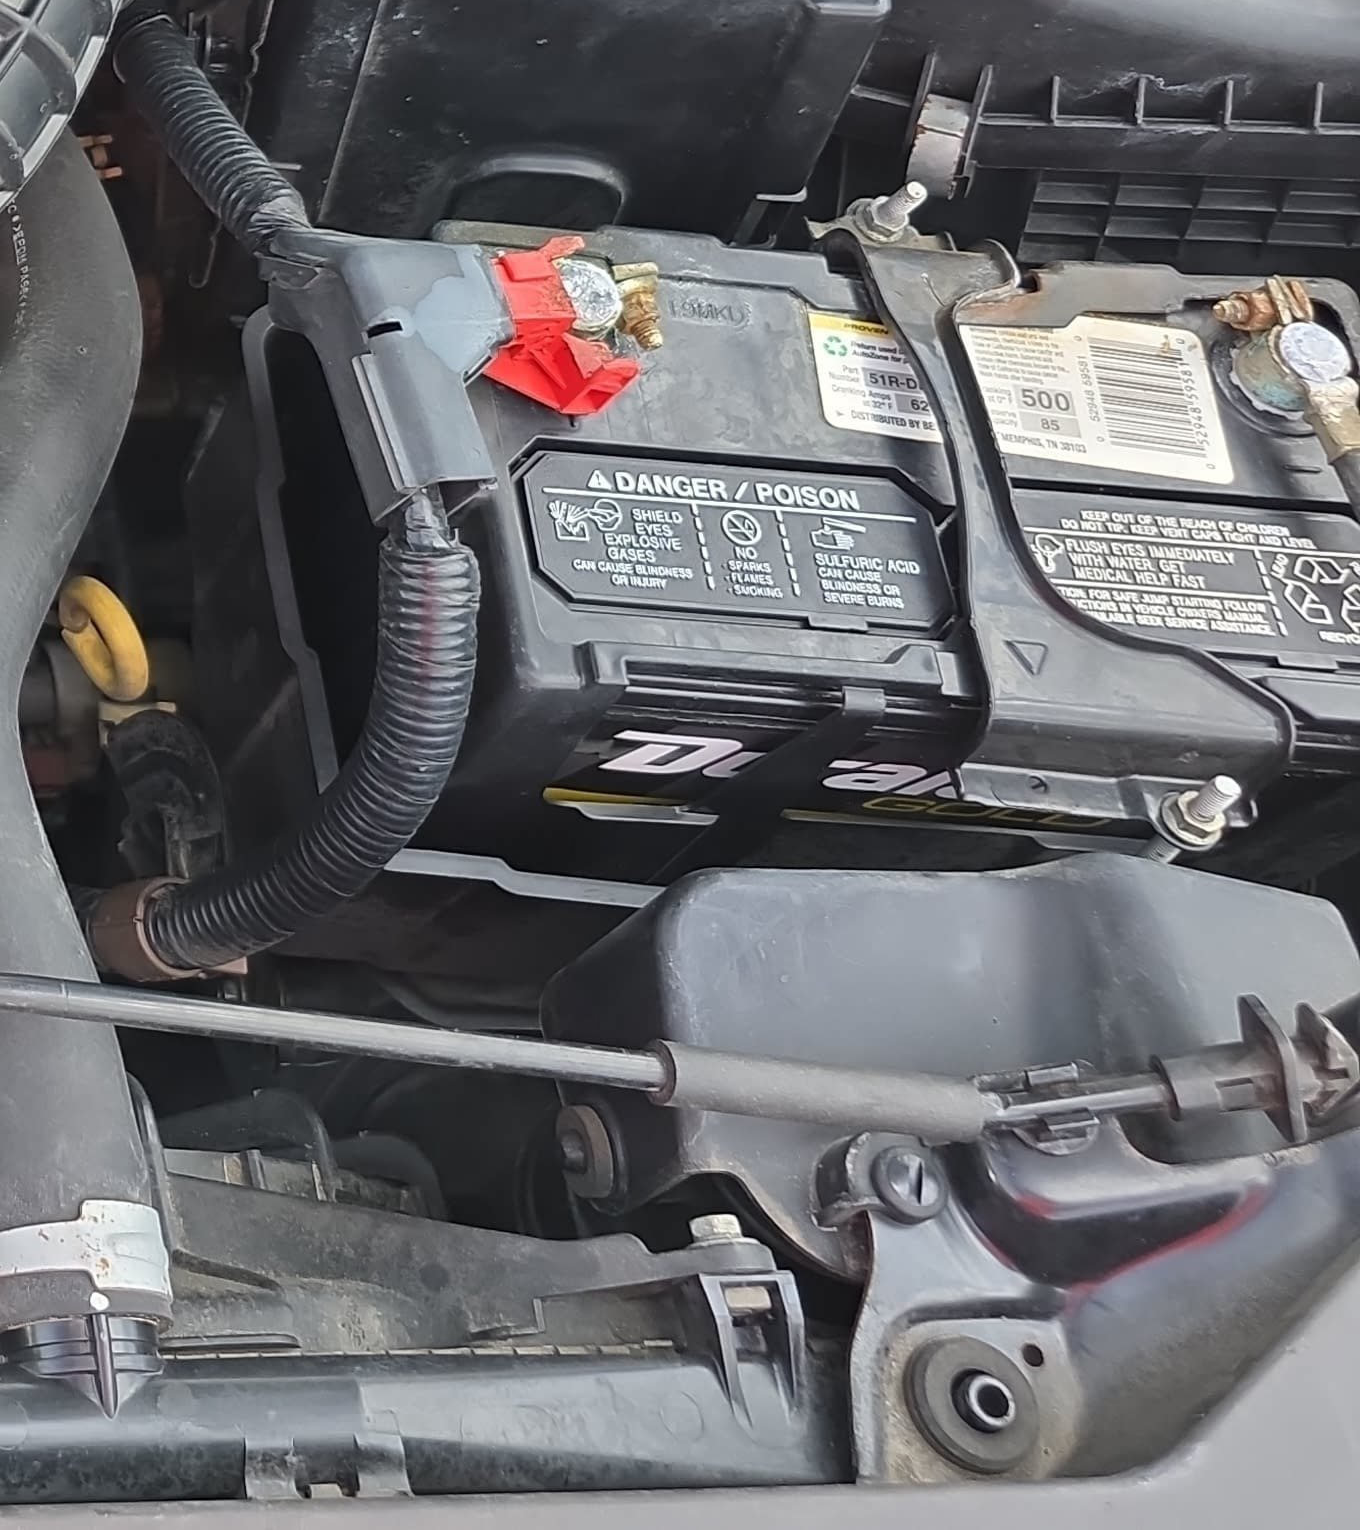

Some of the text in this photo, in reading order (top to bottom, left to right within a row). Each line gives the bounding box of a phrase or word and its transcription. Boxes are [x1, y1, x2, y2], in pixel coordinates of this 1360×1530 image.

[868, 373, 920, 390] 51R-D
[910, 399, 930, 412] 62
[1021, 388, 1071, 413] 500
[1040, 418, 1061, 432] 85
[614, 470, 729, 501] DANGER
[755, 481, 861, 512] POISON
[632, 507, 683, 525] SHIELD
[1080, 510, 1291, 538] KEEP OUT OF THE REACH OF CHILDREN
[634, 522, 674, 537] EYES
[1061, 518, 1079, 531] DO
[1080, 520, 1105, 533] NOT
[1130, 524, 1159, 537] KEEP
[1160, 527, 1190, 540] VENT
[1191, 529, 1223, 543] CAPS
[1224, 531, 1256, 545] TIGHT
[1258, 534, 1282, 547] AND
[1283, 535, 1318, 550] LEVEL
[604, 532, 683, 551] EXPLOSIVE
[606, 546, 657, 563] GASES
[734, 546, 759, 560] NO
[1064, 538, 1236, 566] FLUSH EYES IMMEDIATELY
[572, 558, 694, 580] CAN CAUSE BLINDNESS
[728, 560, 772, 574] SPARKS
[813, 552, 921, 576] SULFURIC ACID
[1067, 552, 1105, 567] WITH
[1158, 559, 1186, 575] GET
[611, 574, 668, 590] OR INJURY
[731, 572, 774, 586] FLAMES
[817, 566, 882, 584] CAN CAUSE
[1073, 566, 1207, 590] MEDICAL HELP FAST
[733, 584, 784, 600] SMOKING
[819, 579, 901, 597] BLINDNESS OR
[823, 591, 905, 610] SEVERE BURNS
[1088, 588, 1111, 602] FOR
[1111, 590, 1139, 604] SAFE
[1140, 593, 1169, 606] JUMP
[1171, 595, 1222, 611] STARTING
[1223, 599, 1267, 613] FOLLOW
[1132, 603, 1175, 618] VEHICLE
[1136, 614, 1164, 627] SEEK
[1165, 616, 1209, 632] SERVICE
[1318, 630, 1360, 646] RECYC
